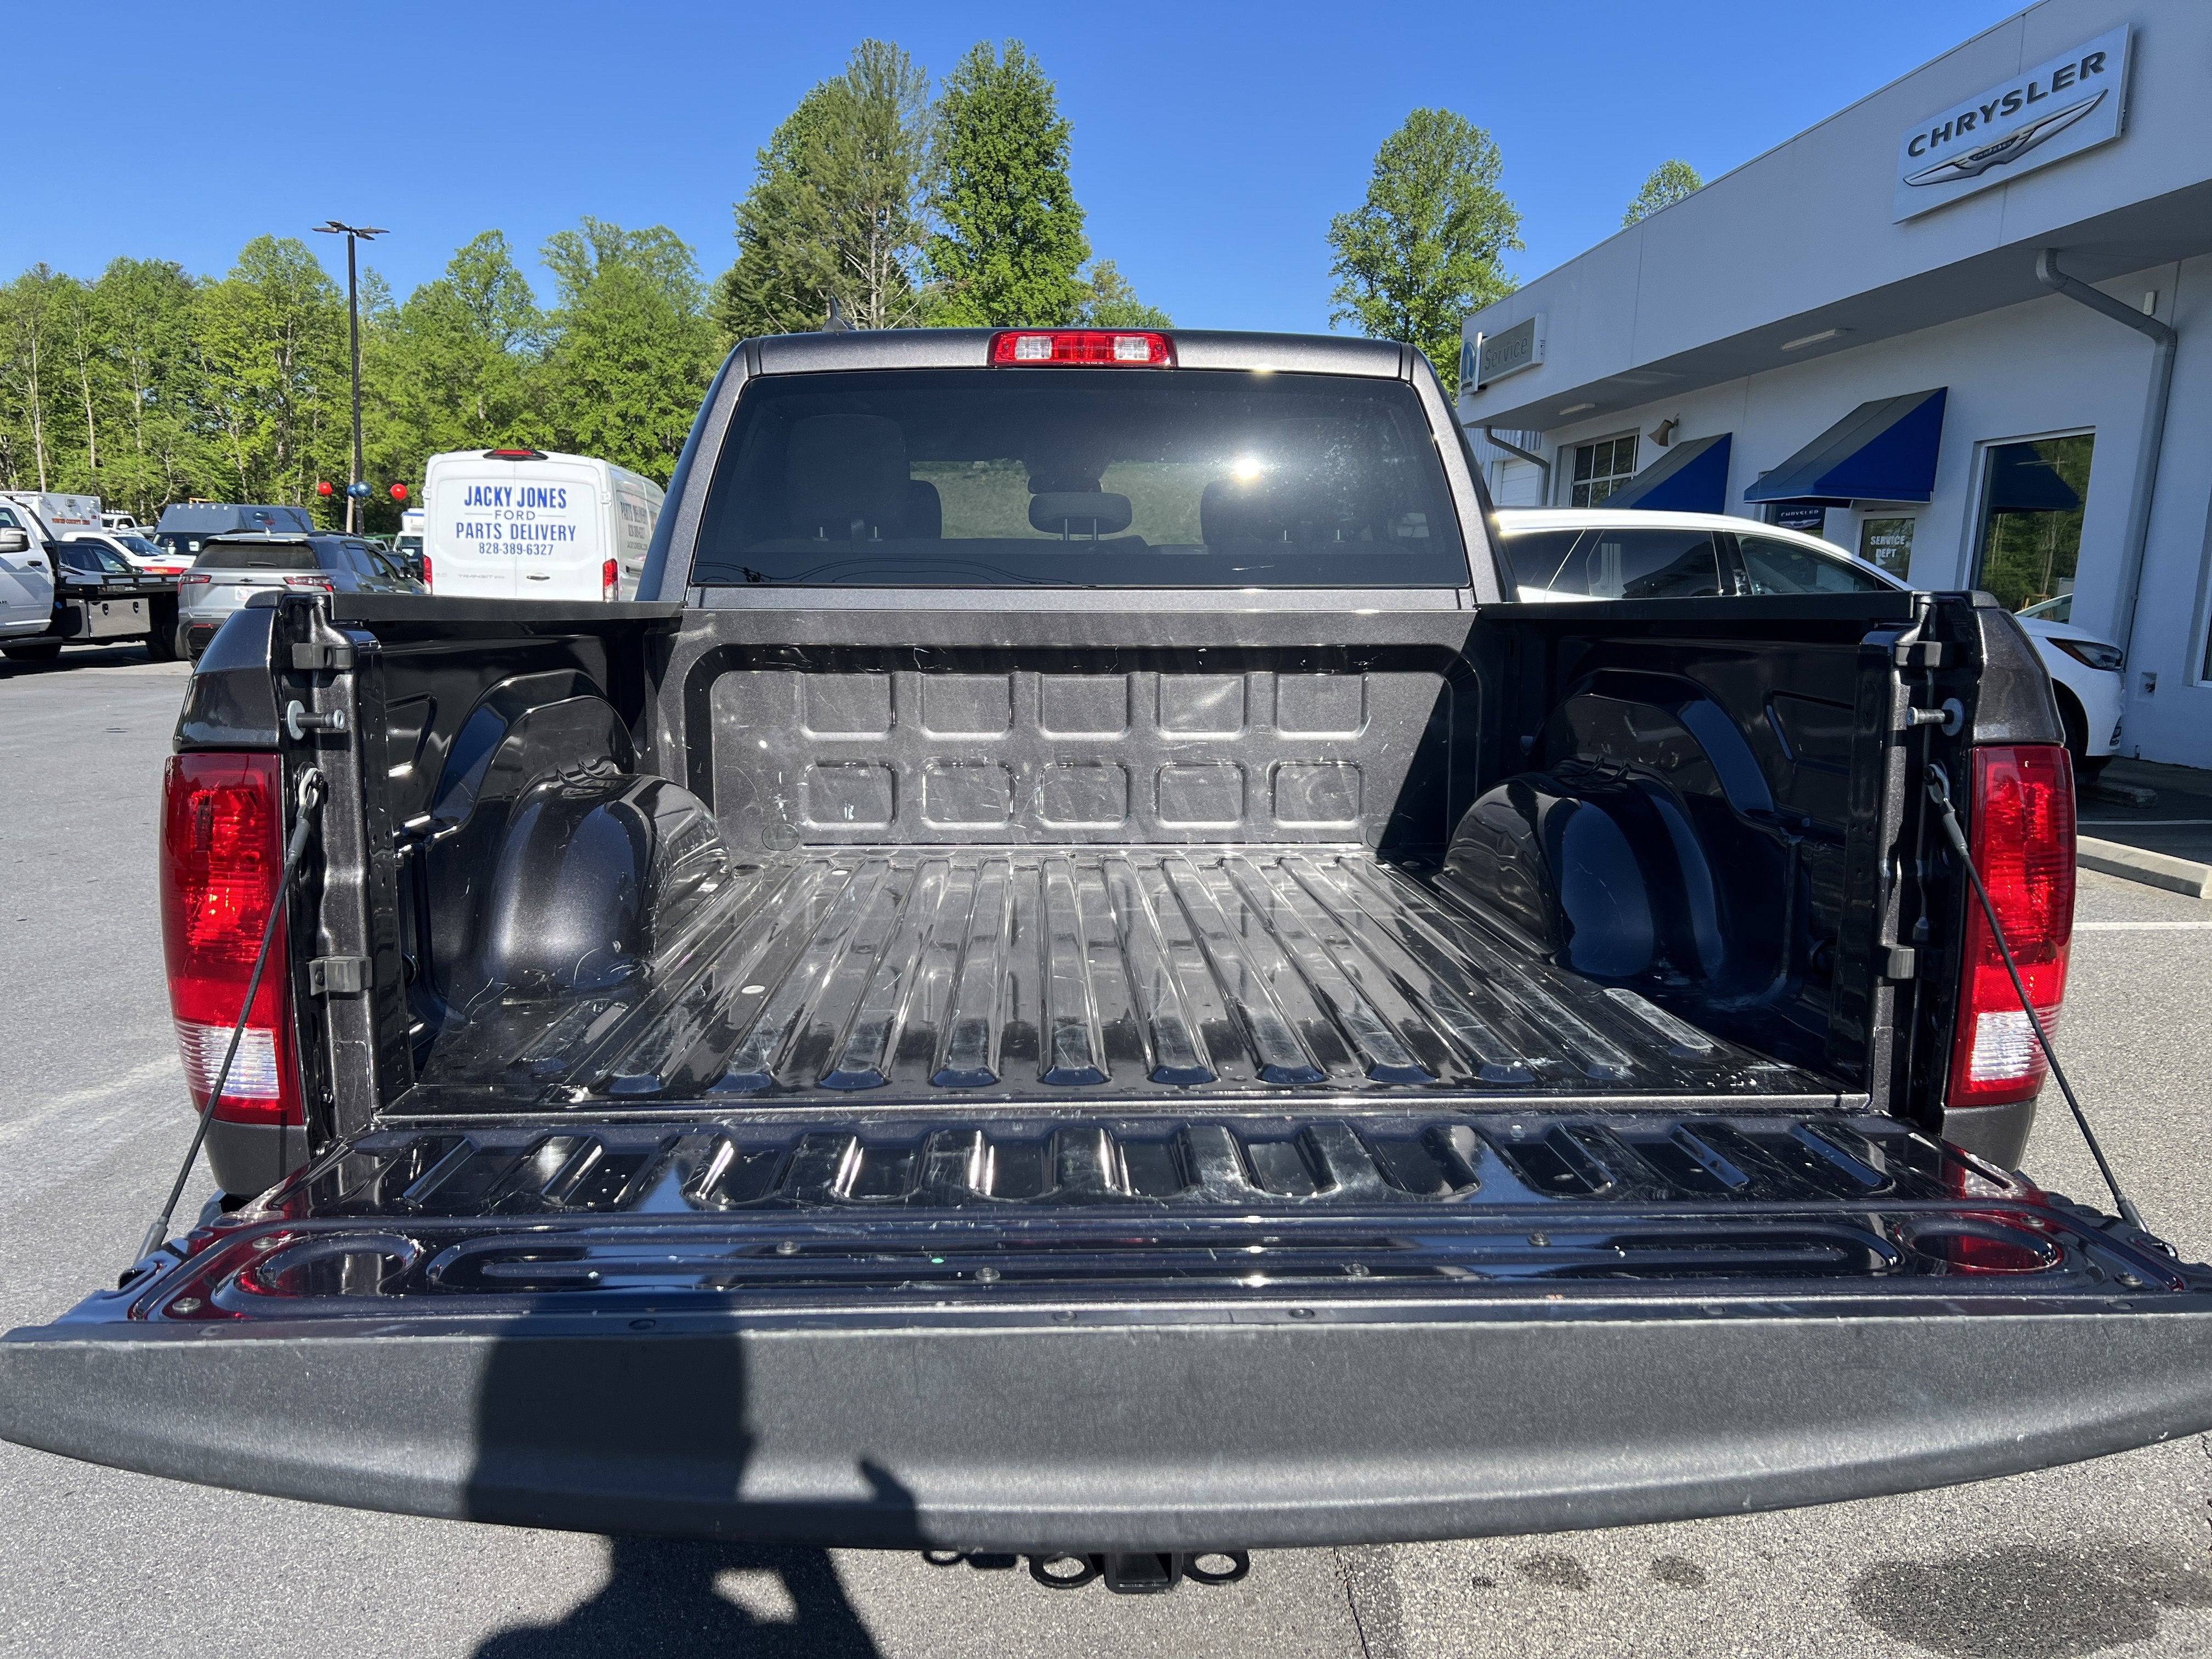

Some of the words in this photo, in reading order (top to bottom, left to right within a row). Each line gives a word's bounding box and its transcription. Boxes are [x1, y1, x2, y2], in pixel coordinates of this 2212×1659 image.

[1908, 51, 2107, 157] CHRYSLER
[1485, 337, 1528, 371] Service
[464, 486, 512, 507] JACKY
[517, 487, 566, 509] JONES
[495, 510, 535, 520] FORD
[456, 522, 502, 539] PARTS
[510, 523, 576, 541] DELIVERY
[1870, 535, 1906, 545] SERVICE
[479, 542, 554, 555] 828-389-6327
[1876, 549, 1897, 557] DEPT
